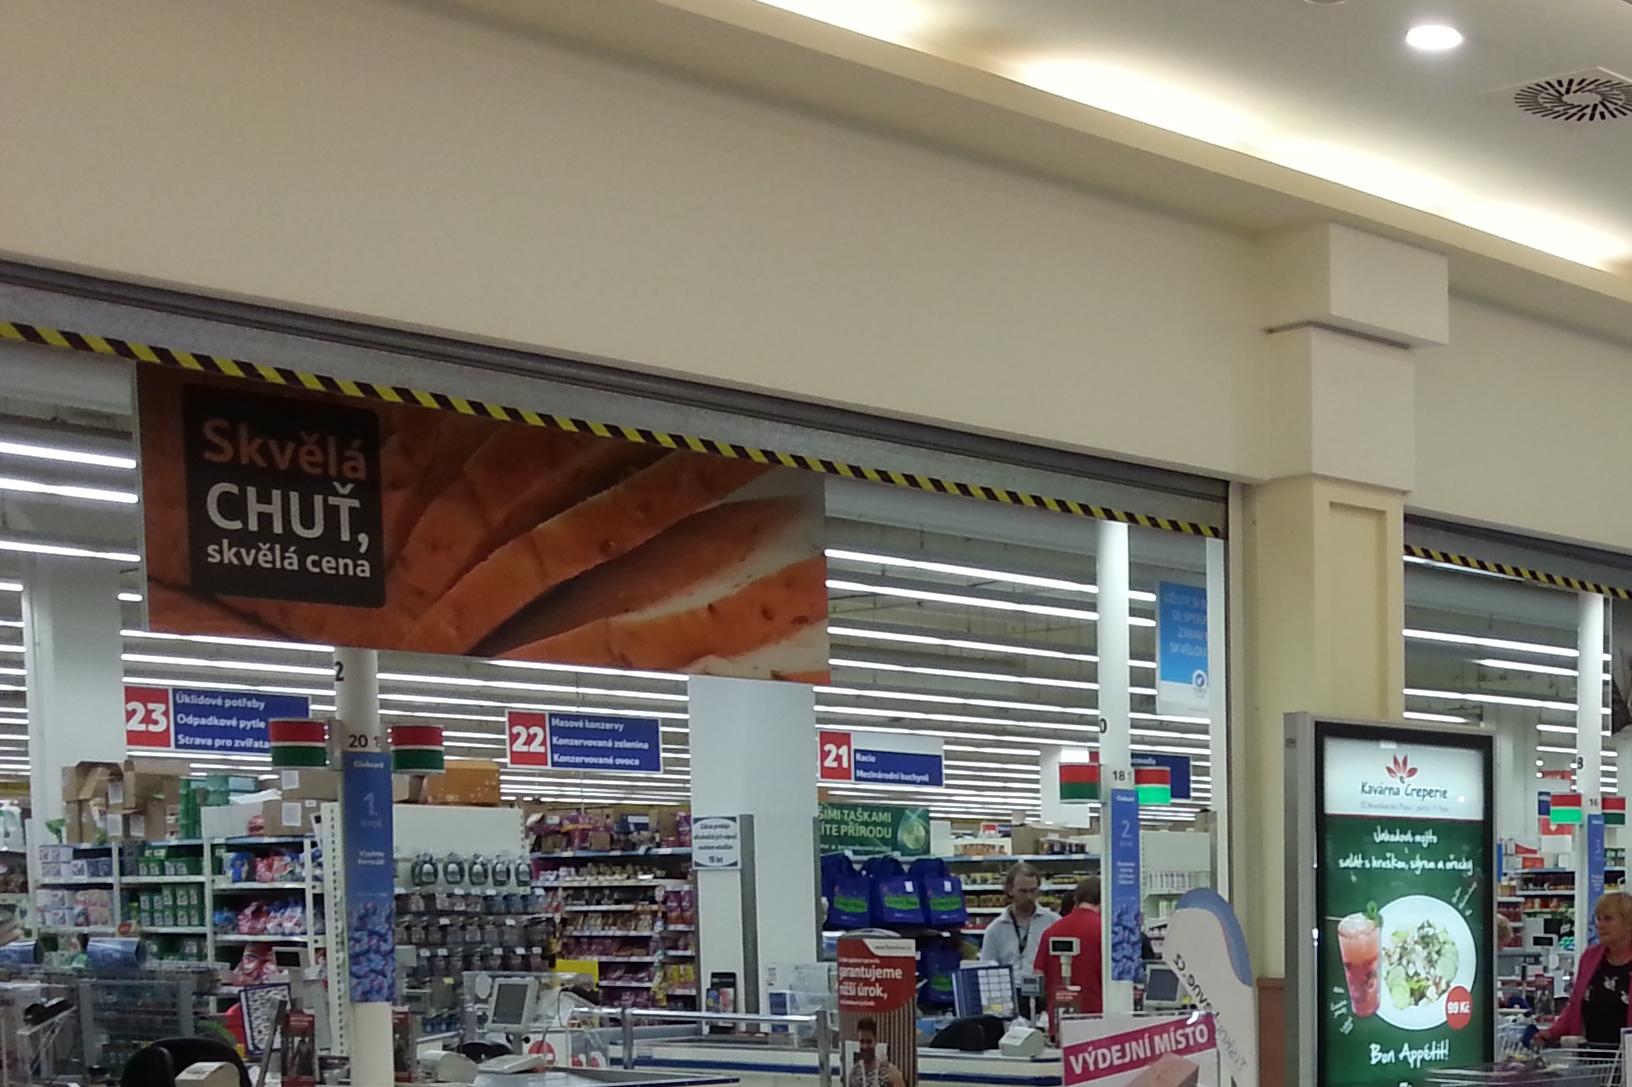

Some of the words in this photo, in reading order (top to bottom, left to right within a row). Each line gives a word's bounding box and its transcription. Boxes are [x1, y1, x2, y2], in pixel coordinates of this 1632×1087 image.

[202, 417, 367, 481] Skvělá
[206, 481, 370, 554] CHUŤ,
[207, 538, 300, 571] skvělá
[305, 554, 372, 579] cena
[176, 691, 223, 708] Úklidové
[224, 696, 266, 712] potřeby
[126, 702, 168, 734] 23
[177, 712, 239, 728] Odpadkové
[239, 717, 266, 731] pytle
[584, 719, 625, 732] konzervy
[177, 734, 213, 748] Strava
[213, 737, 233, 750] pro
[348, 734, 368, 749] 20
[511, 725, 545, 753] 22
[613, 740, 650, 750] zelenina
[614, 757, 641, 766] ovoce
[823, 743, 850, 769] 21
[1112, 769, 1126, 782] 18
[1360, 781, 1400, 796] Kavárna
[1404, 783, 1449, 801] Creperie
[842, 807, 892, 824] TAŠKAMI
[840, 821, 893, 839] PŘÍRODU
[1069, 1032, 1152, 1076] VÝDEJNÍ
[1154, 1022, 1209, 1056] MÍSTO
[1369, 1043, 1396, 1065] Bon
